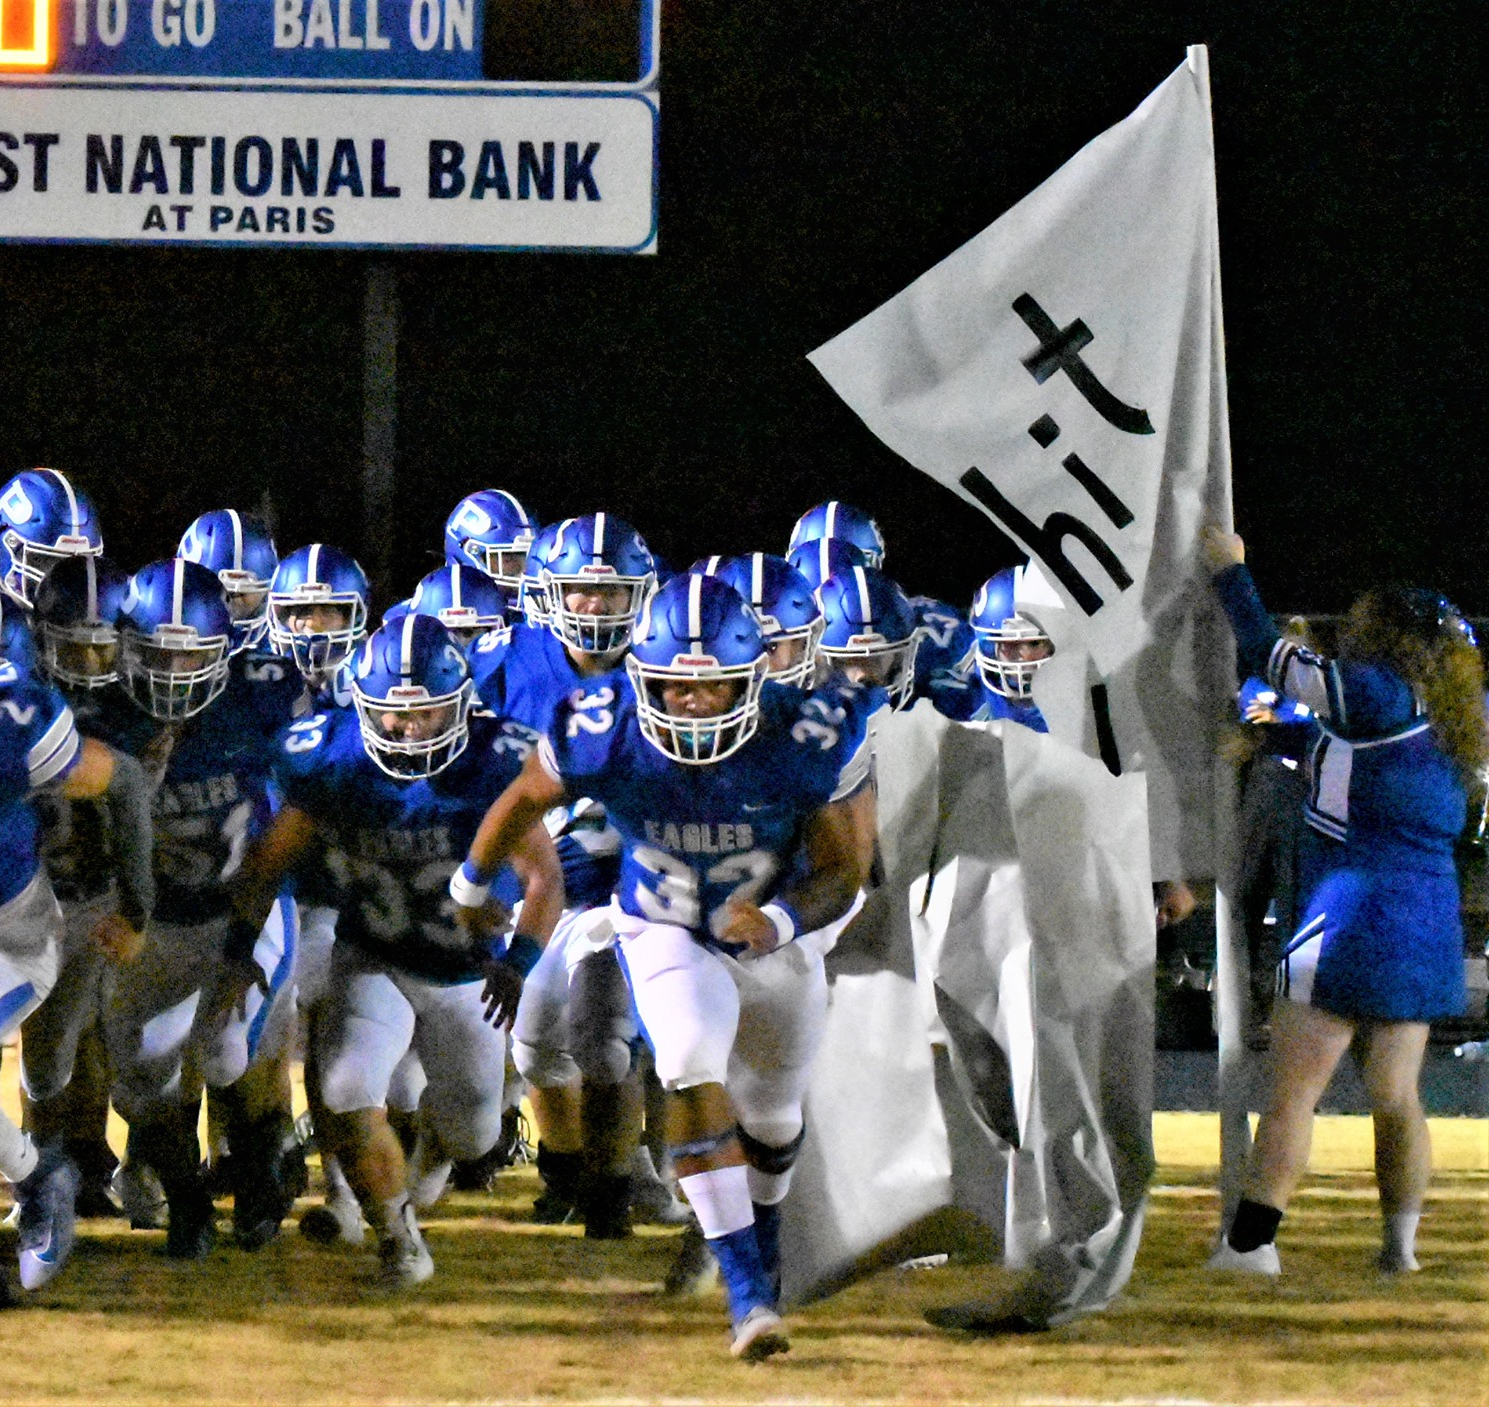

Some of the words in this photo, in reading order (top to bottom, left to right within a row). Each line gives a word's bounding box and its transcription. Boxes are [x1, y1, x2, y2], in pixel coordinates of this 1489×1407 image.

[72, 0, 128, 47] TO
[151, 0, 216, 48] GO
[273, 0, 391, 50] BALL
[410, 0, 475, 52] ON
[85, 133, 402, 198] NATIONAL
[427, 138, 603, 202] BANK
[142, 204, 194, 232] AT
[210, 205, 337, 235] PARIS
[565, 687, 615, 738] 32
[643, 820, 754, 854] EAGLES
